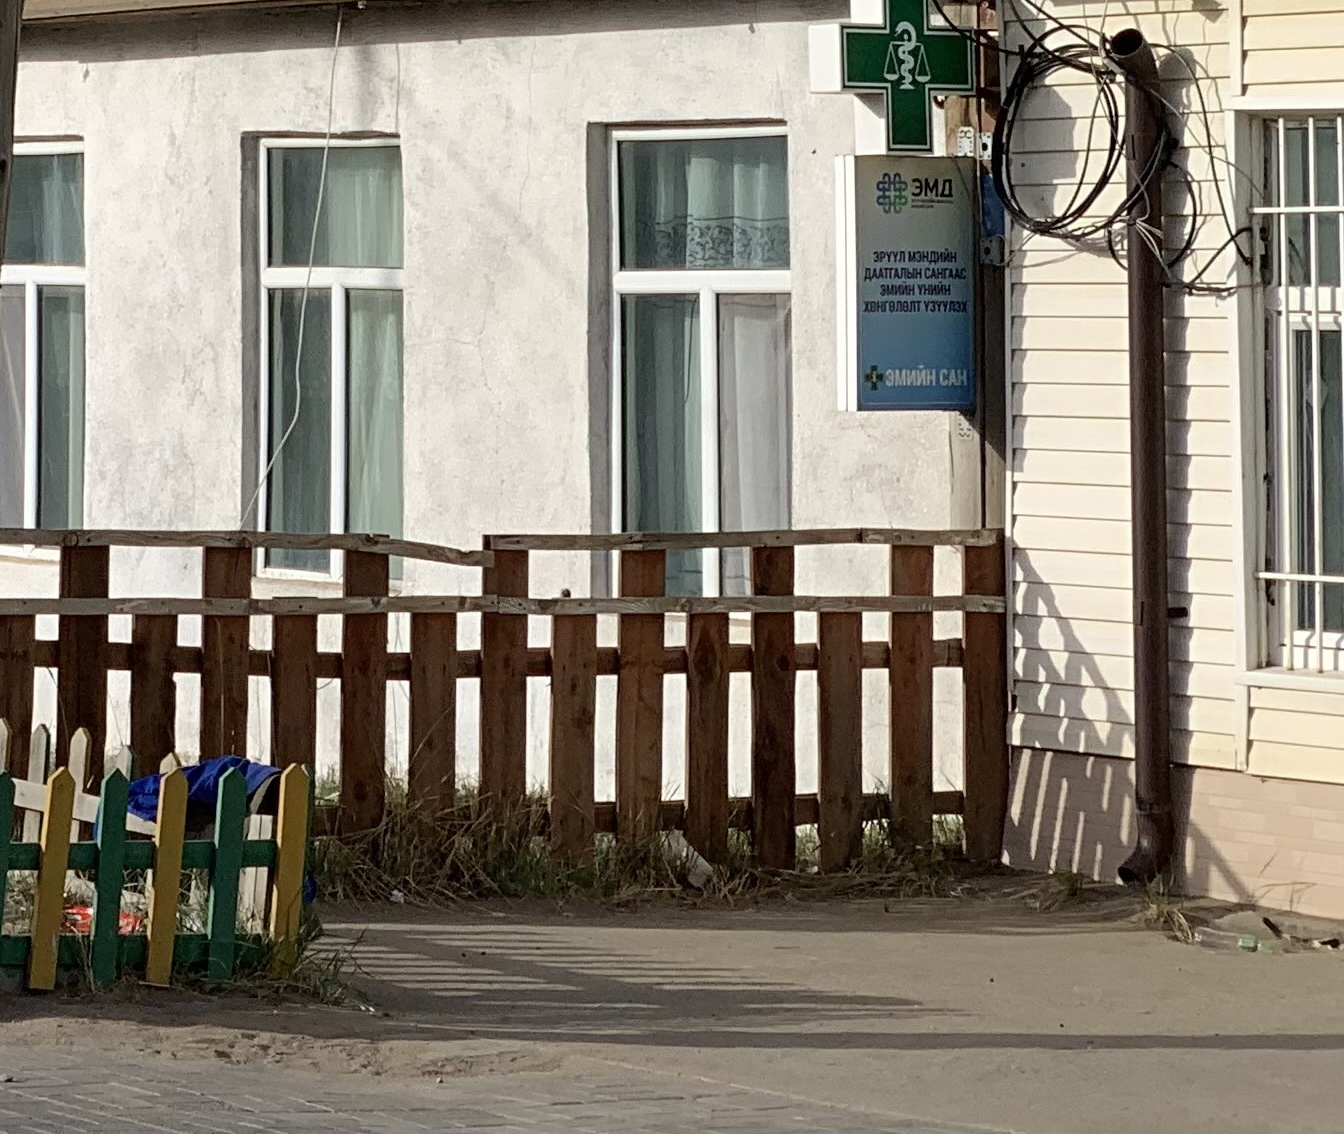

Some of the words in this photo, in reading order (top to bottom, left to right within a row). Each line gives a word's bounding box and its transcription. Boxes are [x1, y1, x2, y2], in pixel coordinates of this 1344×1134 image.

[911, 178, 954, 197] ЭМД
[873, 250, 906, 263] ЭРҮҮЛ
[908, 247, 957, 265] МЭНДИЙН
[864, 267, 922, 282] ДААТГАЛЫН
[924, 267, 967, 280] САНГААС
[879, 281, 915, 296] ЭМИЙН
[917, 281, 951, 296] ҮНИЙН
[863, 300, 922, 313] ХӨНГӨЛӨЛТ
[923, 300, 968, 313] ҮЗҮҮЛЭХ
[885, 364, 936, 387] ЭМИЙН
[939, 368, 968, 387] САН
